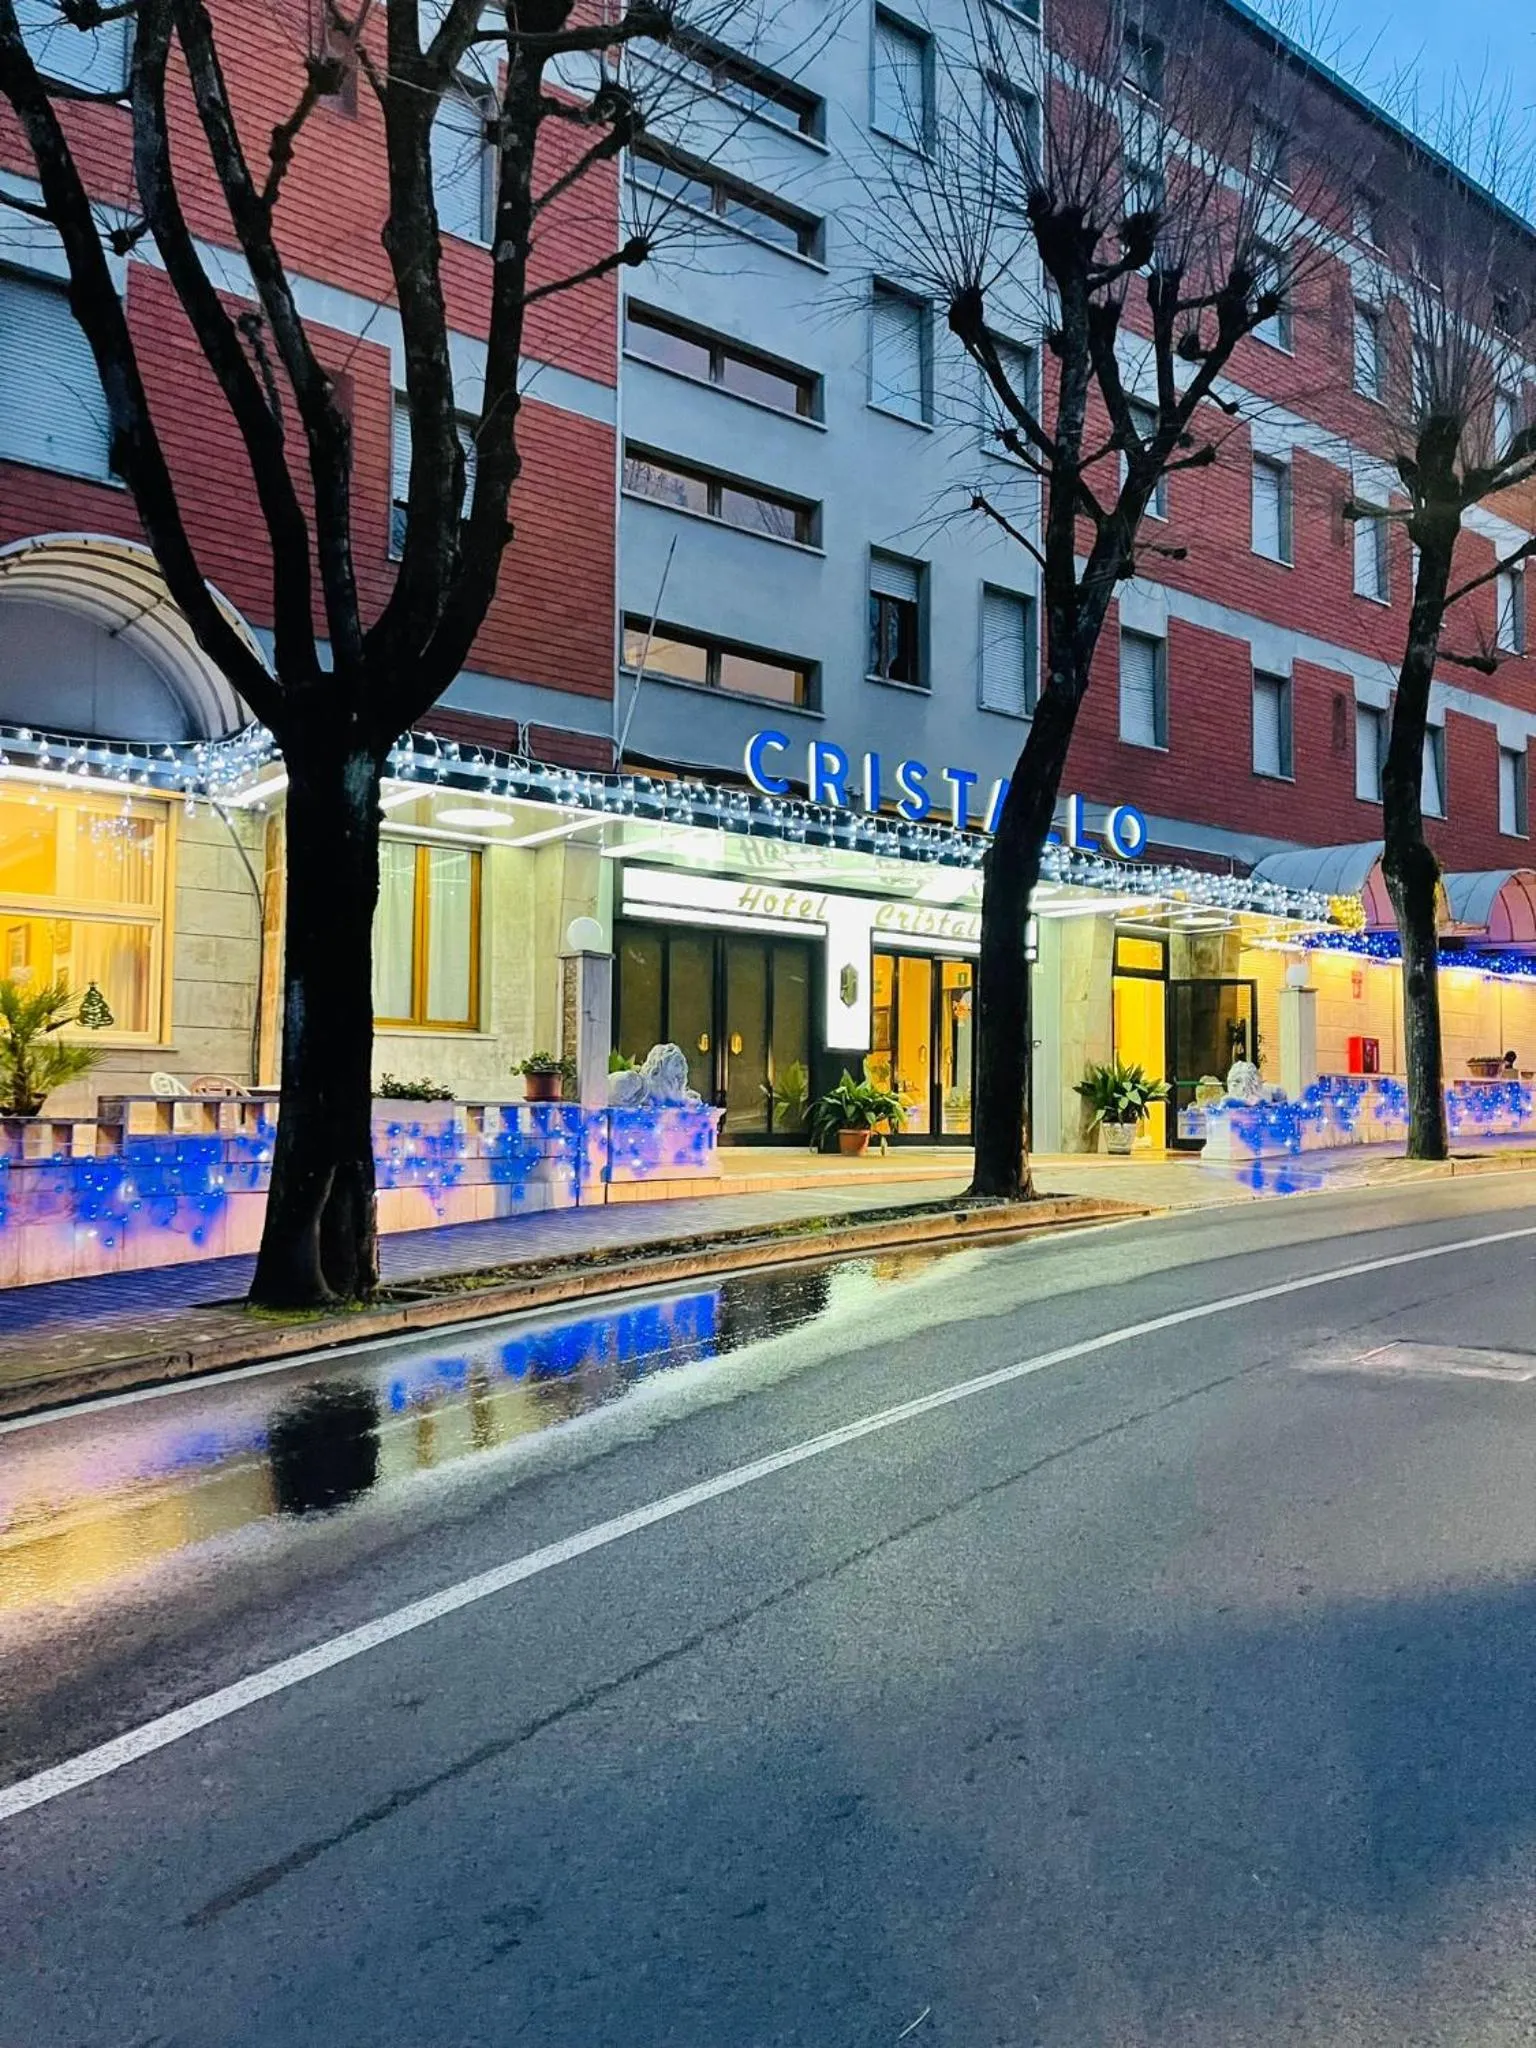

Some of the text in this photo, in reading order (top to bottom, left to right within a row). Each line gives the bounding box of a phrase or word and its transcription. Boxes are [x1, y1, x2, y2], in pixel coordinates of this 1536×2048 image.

[744, 730, 1148, 859] CRISTLO
[738, 885, 980, 938] Hotel Cristal
